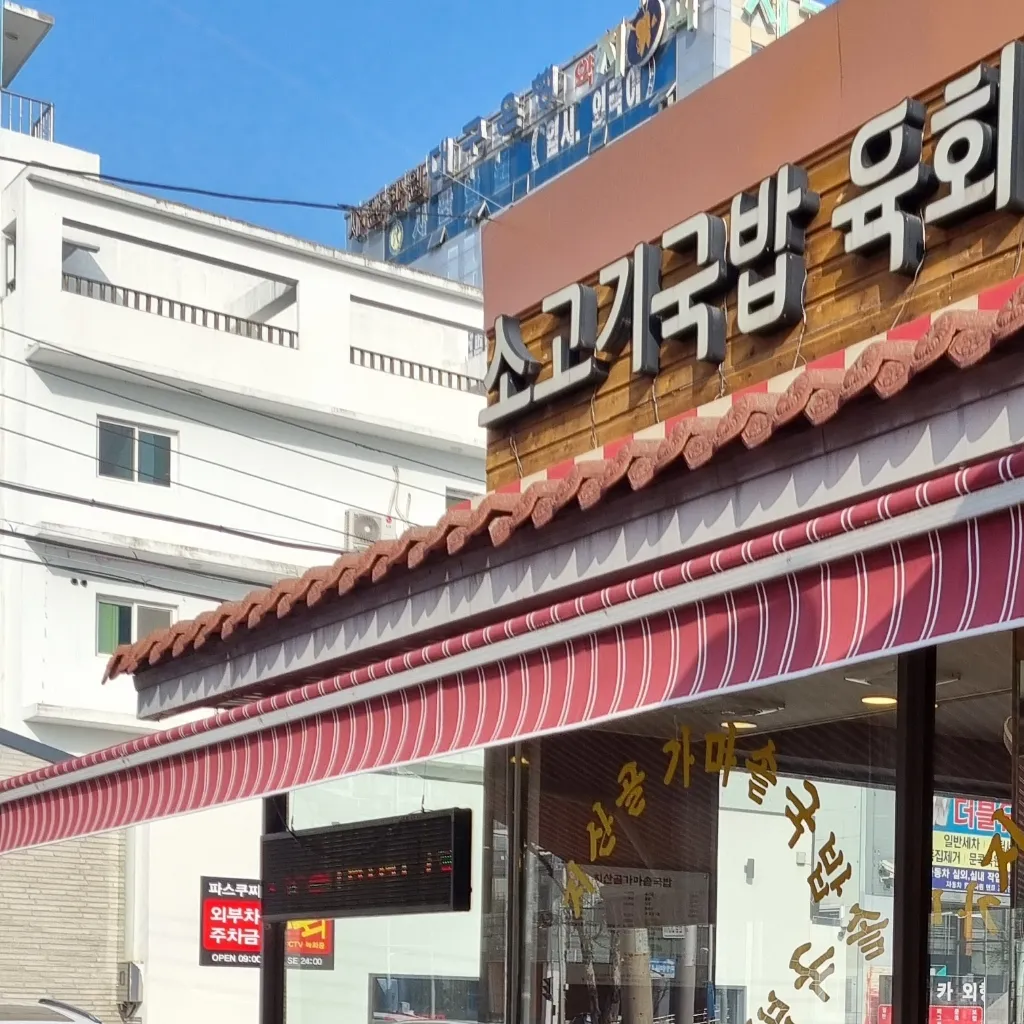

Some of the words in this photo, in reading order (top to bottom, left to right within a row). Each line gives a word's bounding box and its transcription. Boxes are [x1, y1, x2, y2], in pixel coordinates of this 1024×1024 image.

[478, 163, 812, 427] 소고기국밥
[943, 834, 980, 850] 일반세차
[932, 867, 950, 879] 동차
[210, 906, 261, 925] 외부차
[209, 927, 261, 945] 주차금
[212, 953, 236, 963] OPEN
